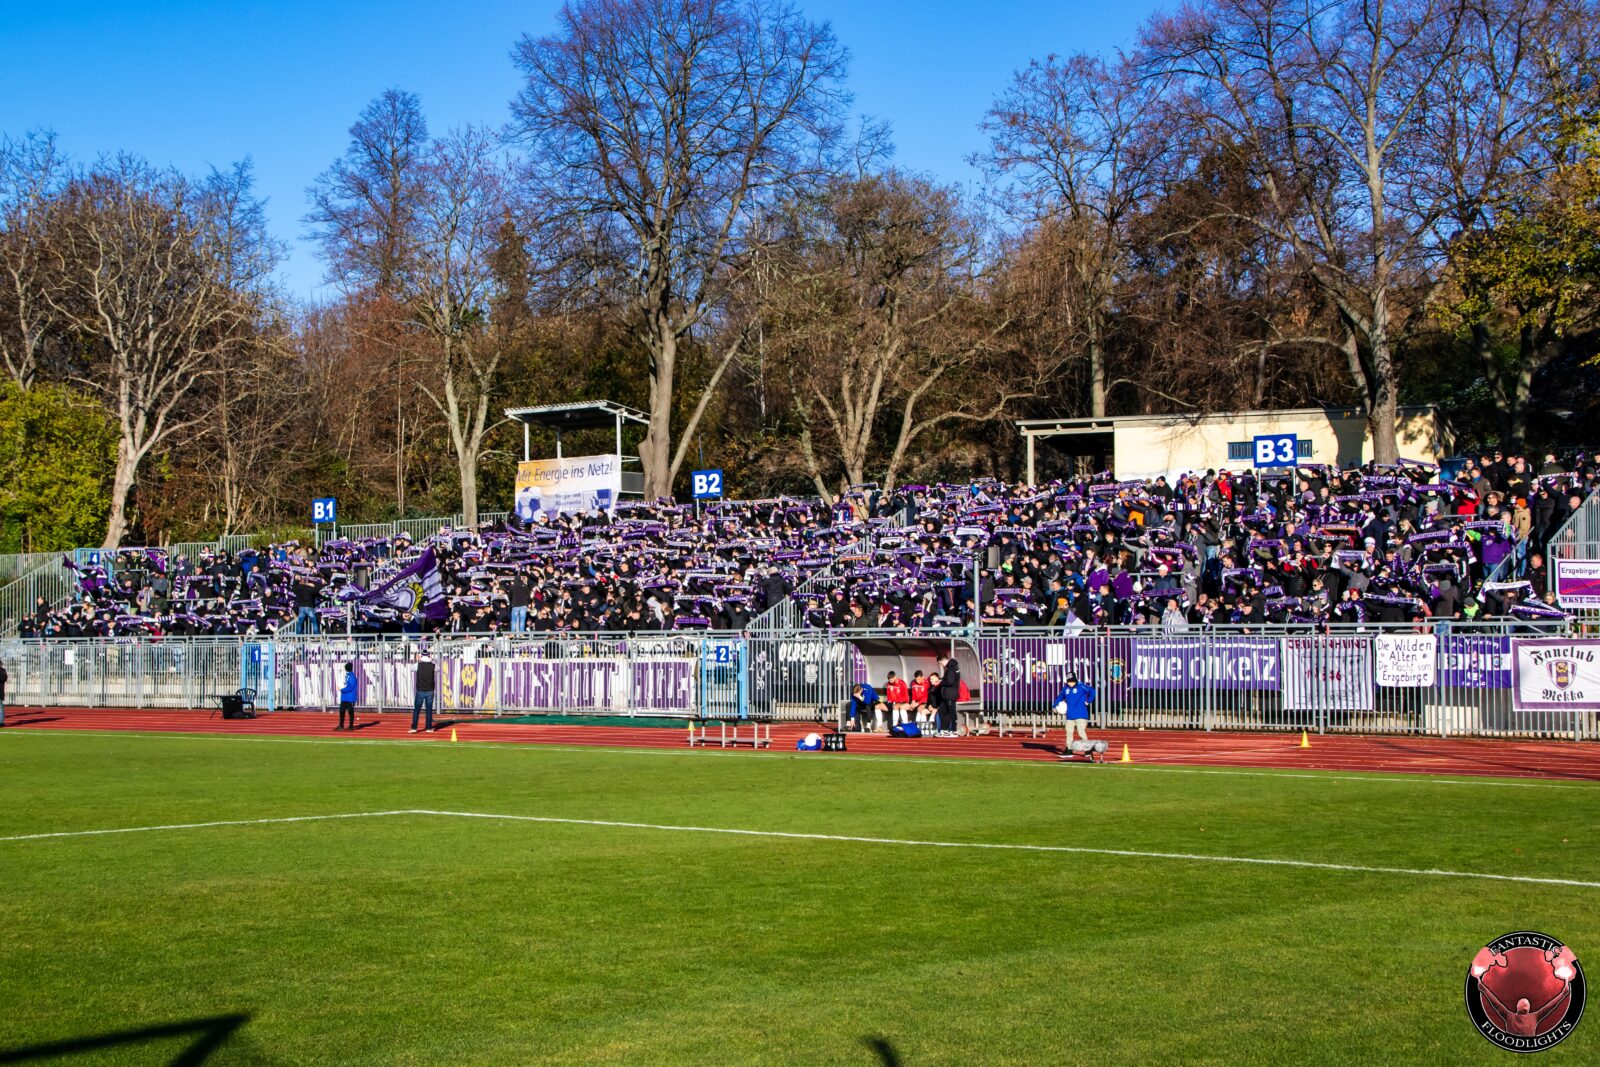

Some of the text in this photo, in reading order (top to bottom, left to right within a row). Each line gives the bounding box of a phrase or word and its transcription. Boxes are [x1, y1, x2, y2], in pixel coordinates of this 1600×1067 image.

[1256, 438, 1295, 463] B3
[515, 461, 613, 484] Mit Energie ins Netz!
[694, 473, 720, 494] B2
[92, 554, 98, 563] 4
[1561, 567, 1599, 575] Erzgebirger
[1377, 638, 1432, 651] Die Wilden
[254, 650, 259, 661] 1
[719, 647, 727, 661] 2
[1389, 651, 1418, 662] Alten
[1530, 646, 1594, 665] Fanclub
[1190, 650, 1276, 681] onkelz
[1392, 660, 1414, 672] Macht
[1382, 671, 1428, 687] Erzgebirge
[1542, 689, 1584, 701] Mekka
